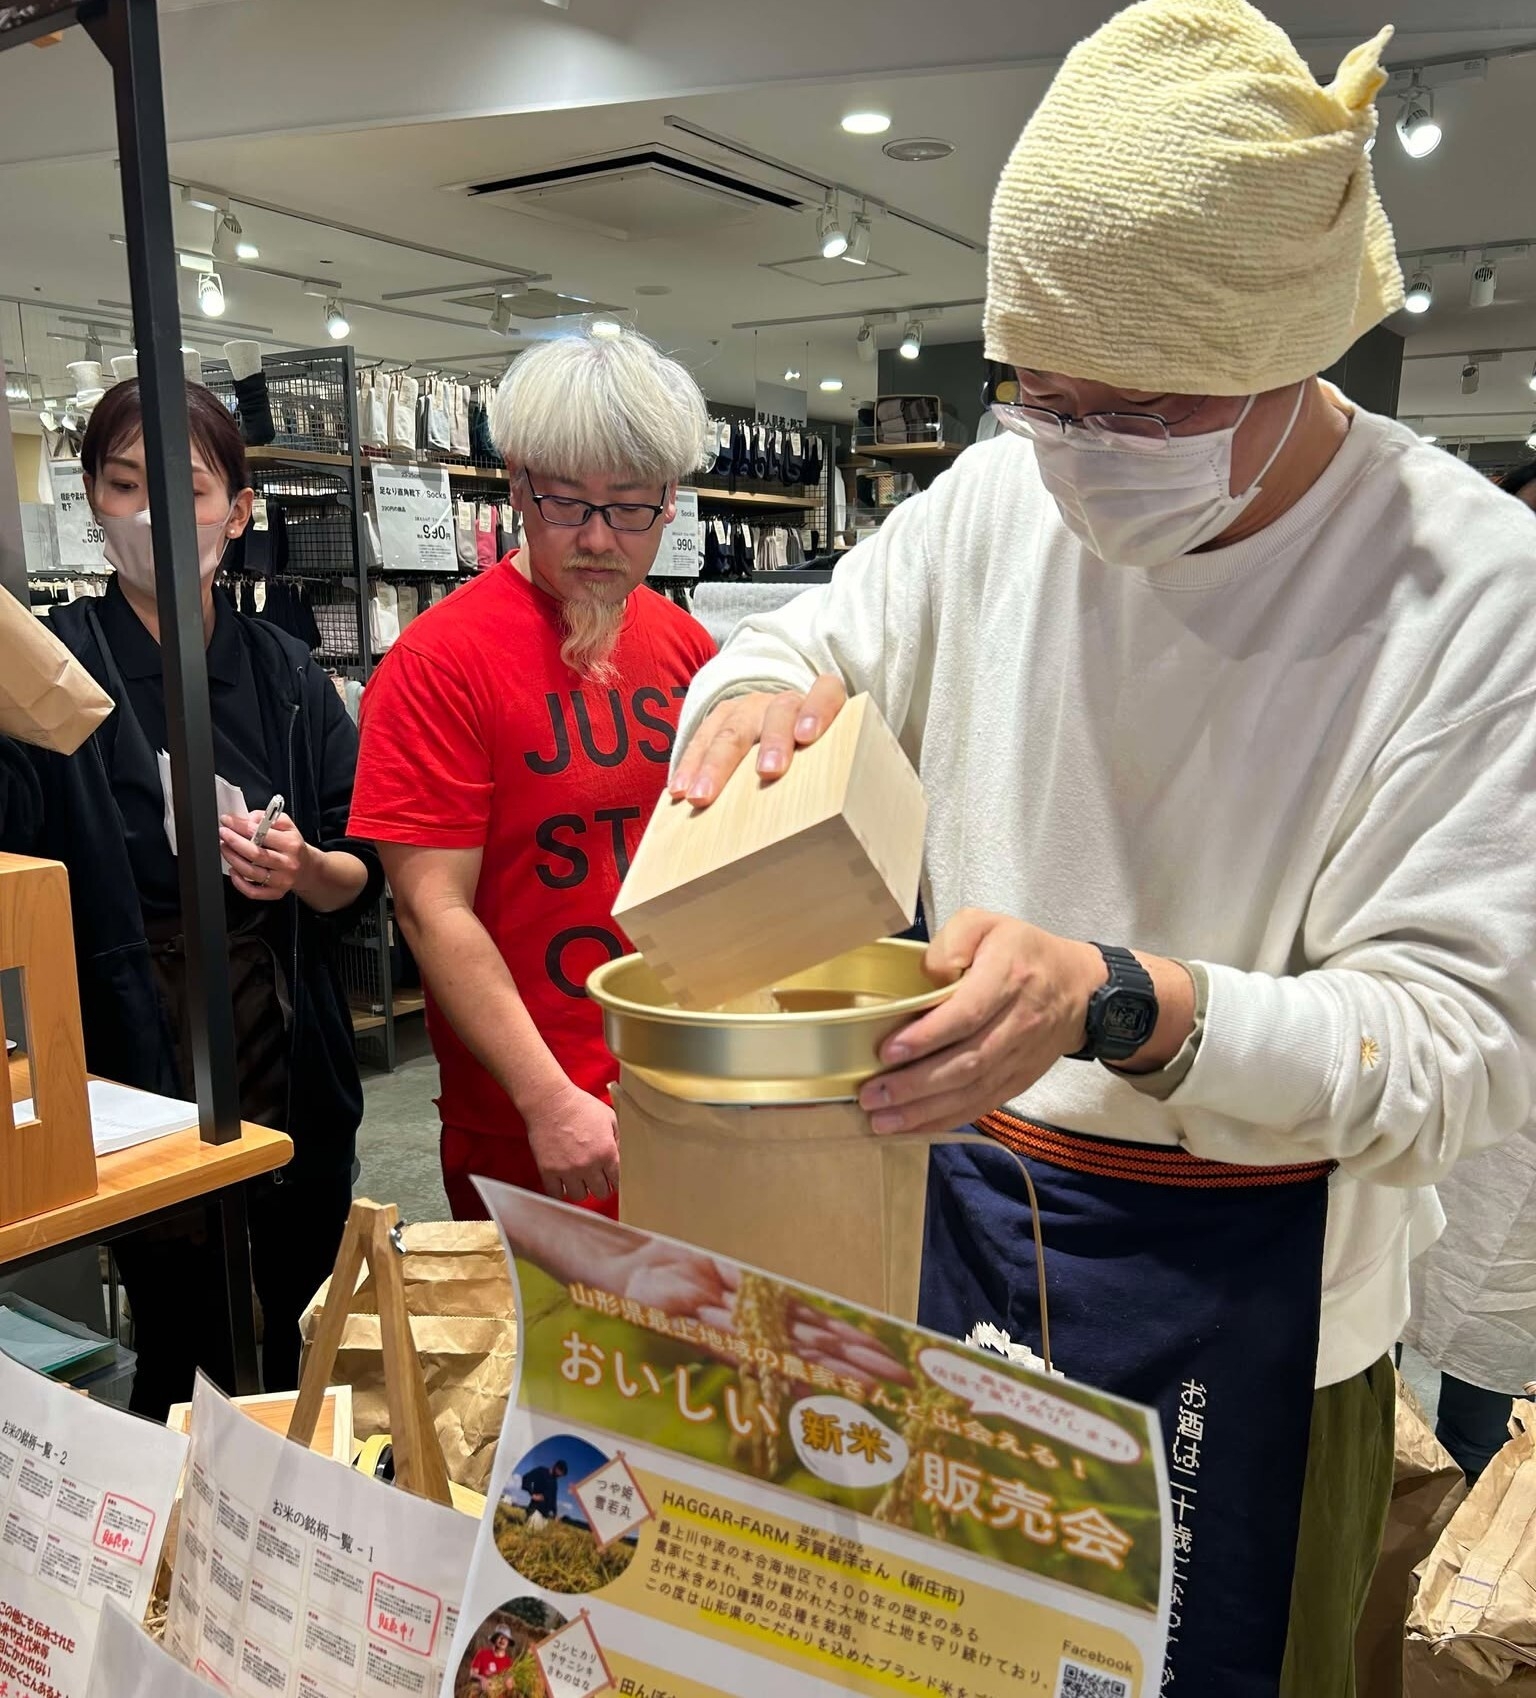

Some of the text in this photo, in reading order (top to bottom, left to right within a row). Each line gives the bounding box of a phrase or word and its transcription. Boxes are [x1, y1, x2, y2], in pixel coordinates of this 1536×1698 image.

[560, 1331, 1134, 1571] おいしい 新米 販売会
[597, 1480, 634, 1501] つや姫
[272, 1499, 355, 1554] お米の銘柄一覧
[662, 1489, 791, 1546] HAGGAR-FARM
[552, 1639, 597, 1664] コシヒカリ
[1062, 1639, 1133, 1674] Facebook
